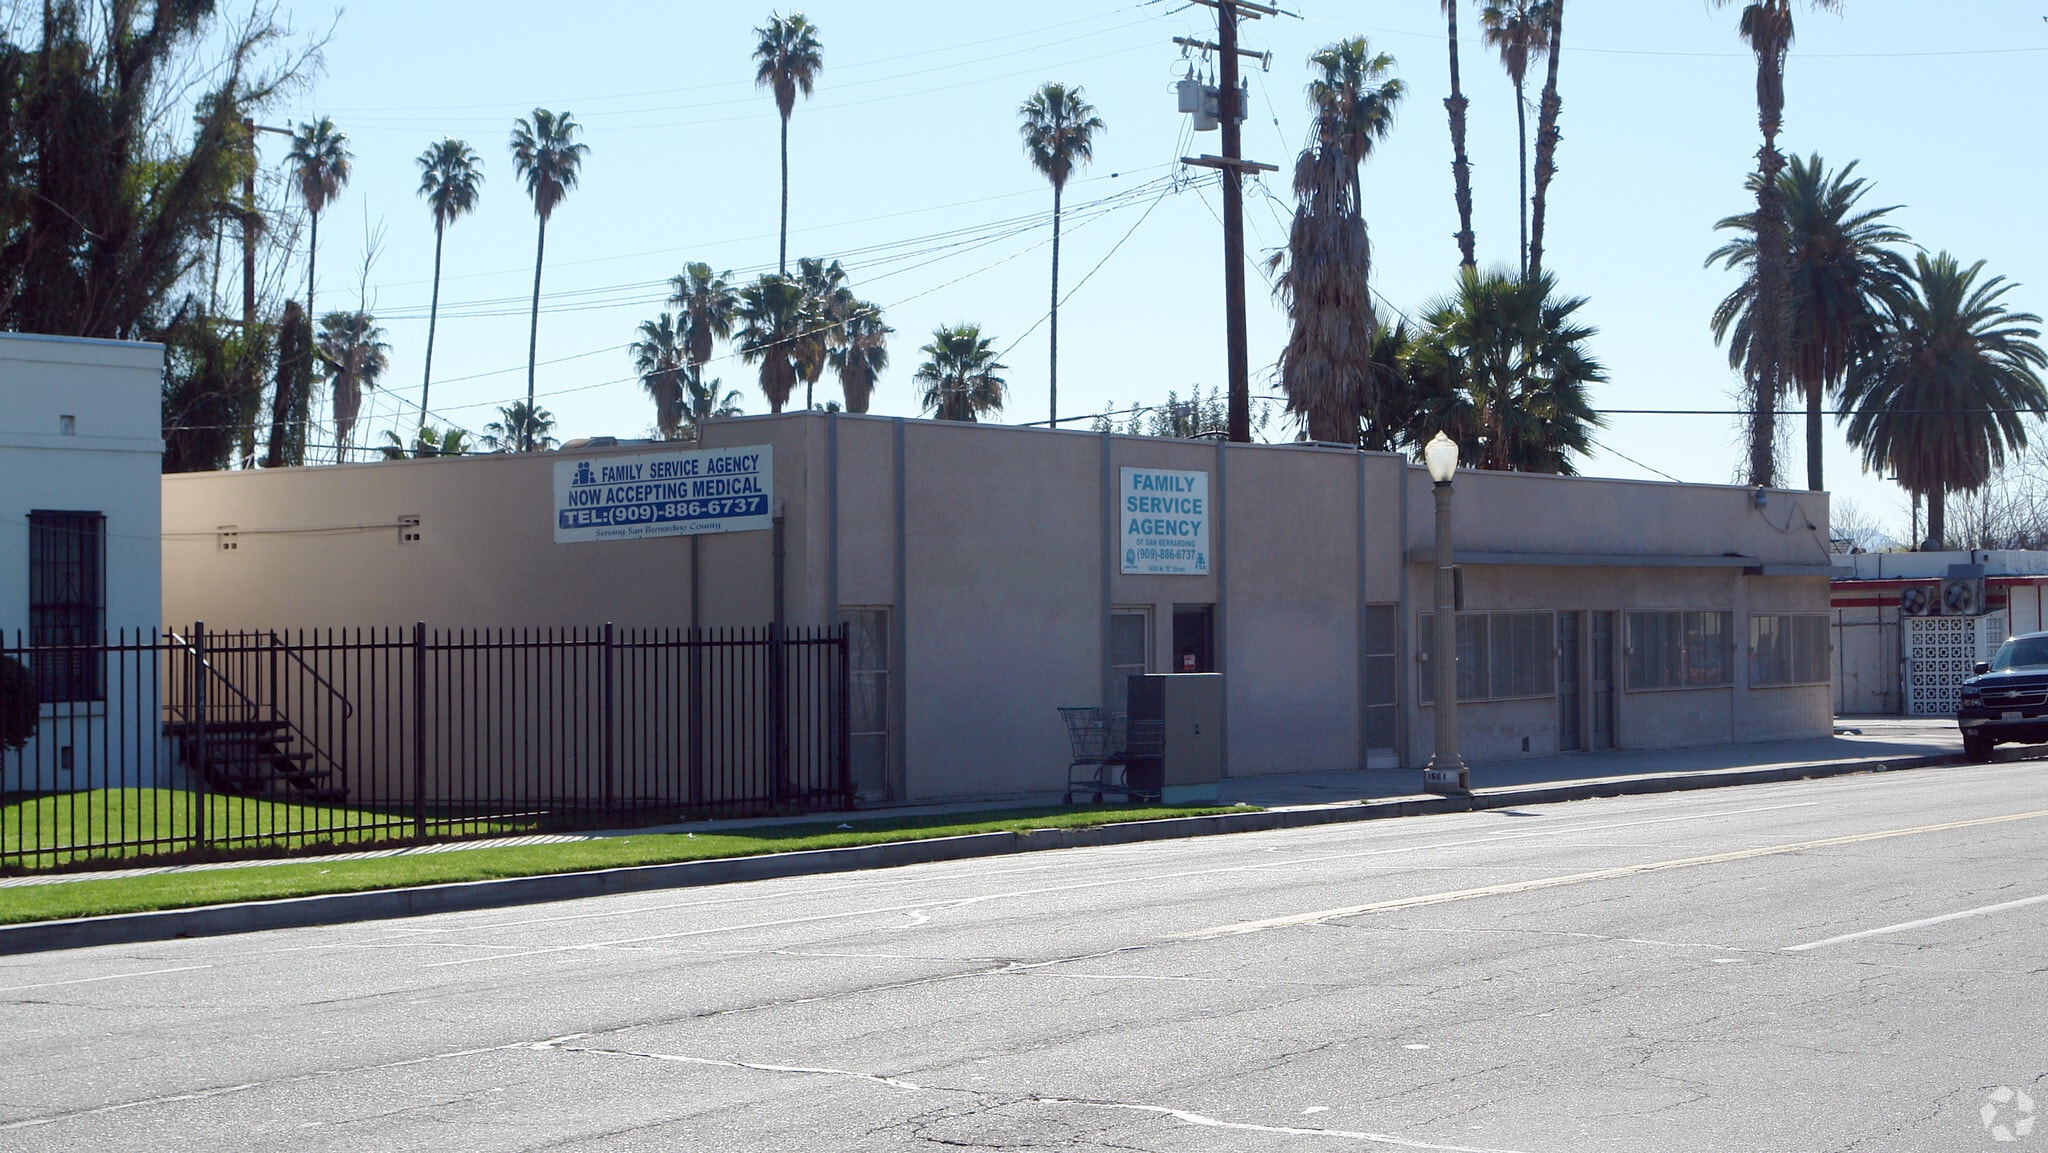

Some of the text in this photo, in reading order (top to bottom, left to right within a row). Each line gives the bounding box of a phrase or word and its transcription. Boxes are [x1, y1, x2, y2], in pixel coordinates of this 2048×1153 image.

[602, 454, 759, 482] FAMILY SERVICE AGENCY
[568, 476, 762, 507] NOW ACCEPTING MEDICAL
[1133, 474, 1195, 492] FAMILY
[564, 497, 761, 525] TEL:(909)-886-6737
[1127, 496, 1202, 514] SERVICE
[596, 521, 721, 537] Serving San Bernardino County
[1128, 518, 1202, 536] AGENCY
[1136, 538, 1196, 548] OF SAN BERNARDINO
[1137, 549, 1196, 560] (909)-886-6737
